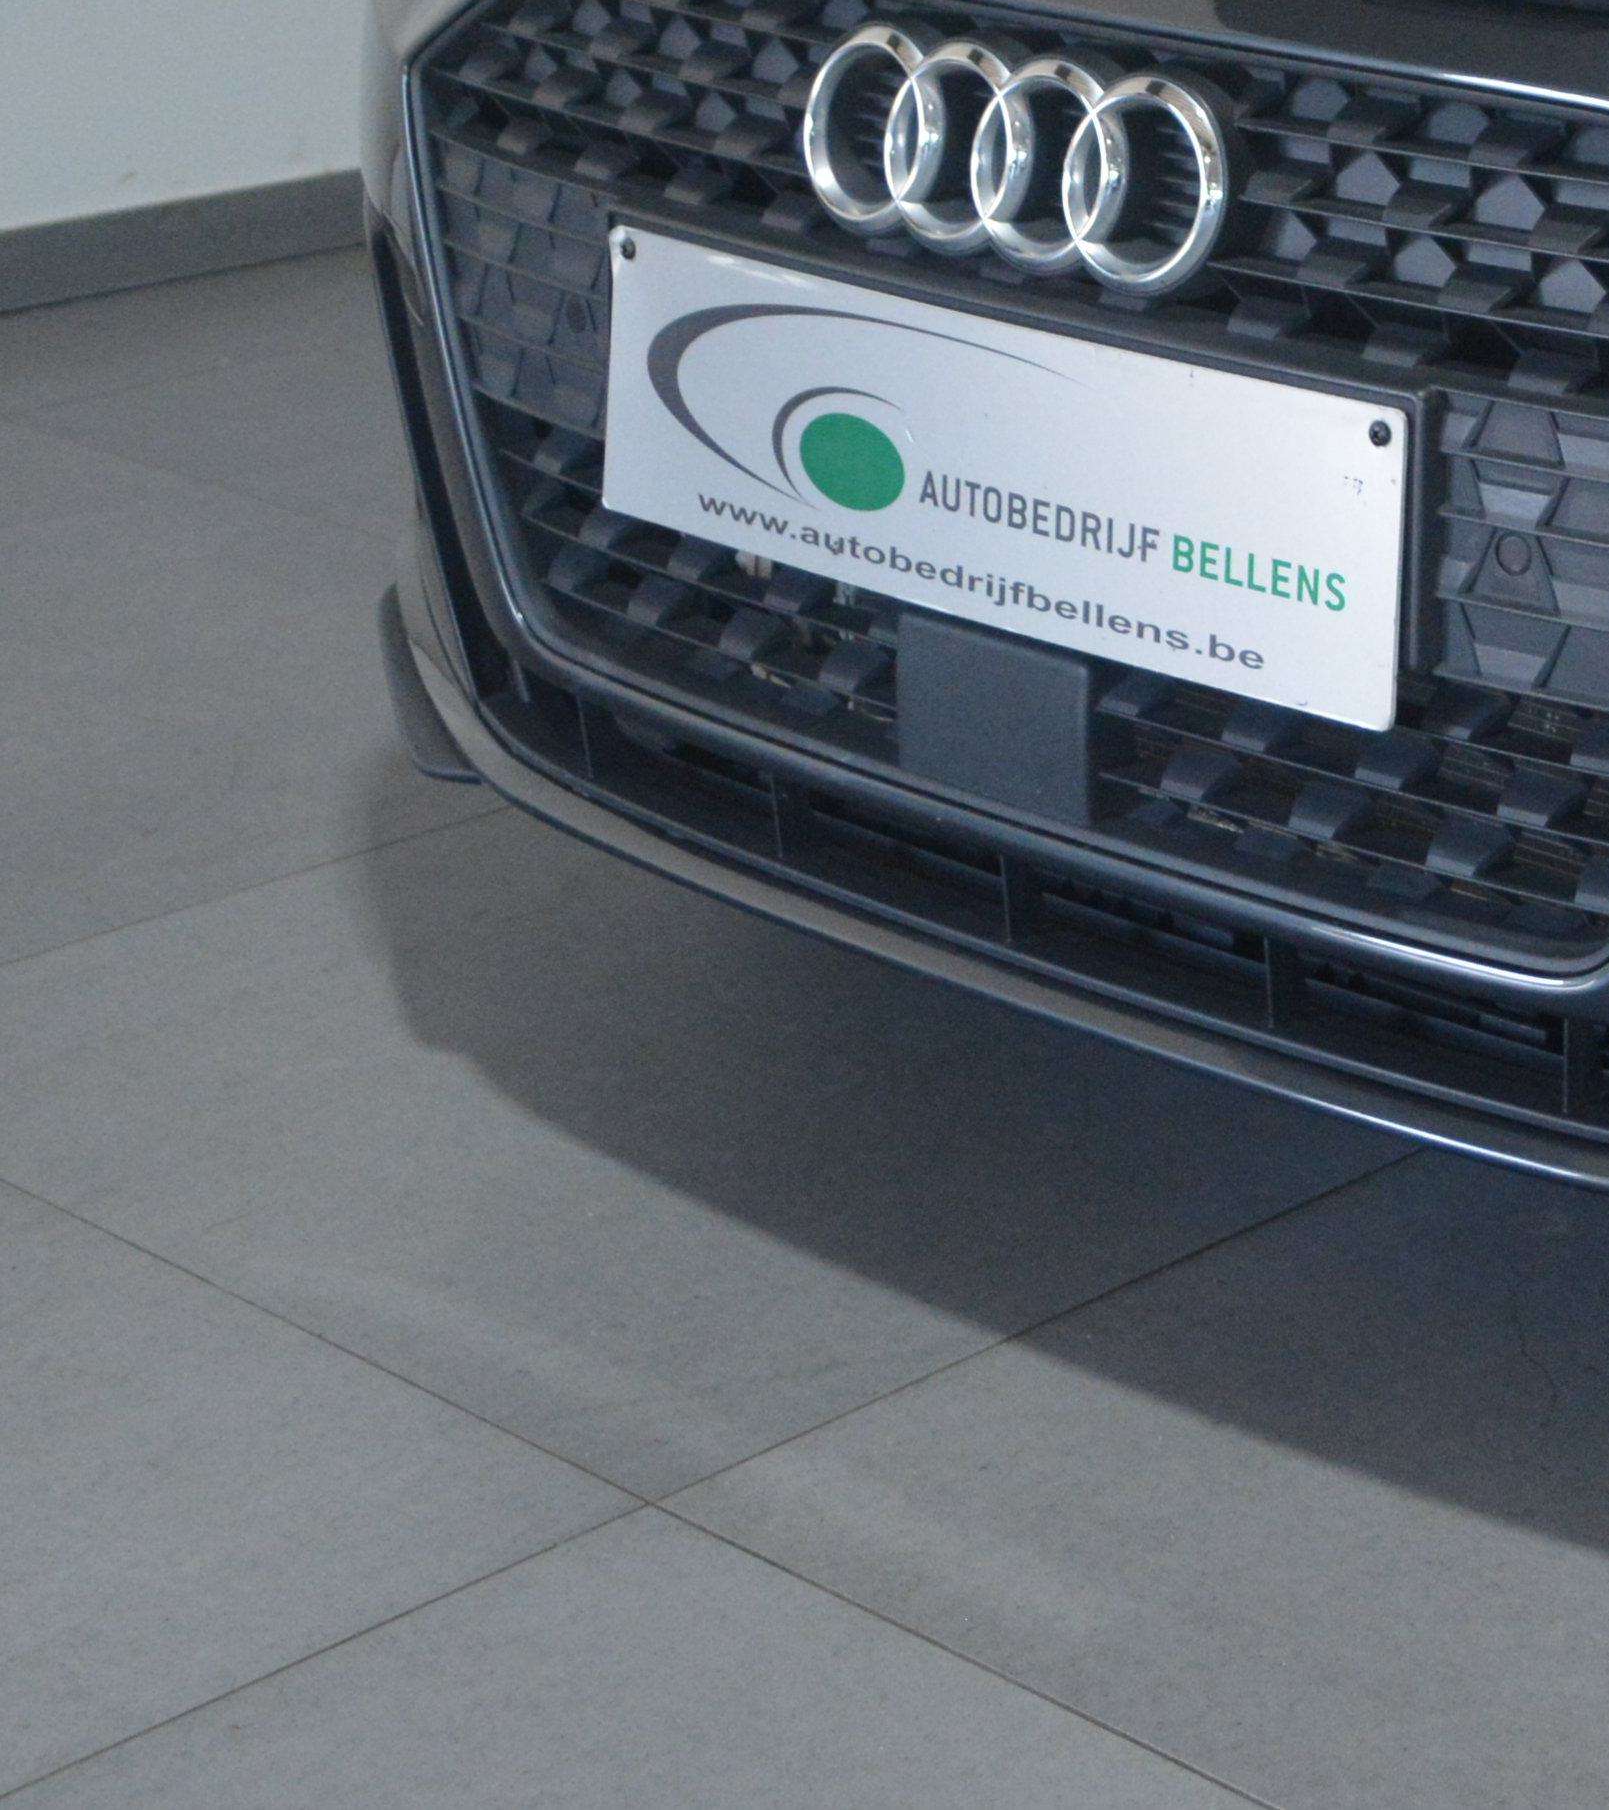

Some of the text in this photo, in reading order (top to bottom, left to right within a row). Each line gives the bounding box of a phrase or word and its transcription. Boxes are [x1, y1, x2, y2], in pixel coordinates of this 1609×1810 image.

[698, 493, 1266, 671] www.autobedrijfbellens.be
[918, 469, 1348, 613] AUTOBEDRIJF BELLENS
